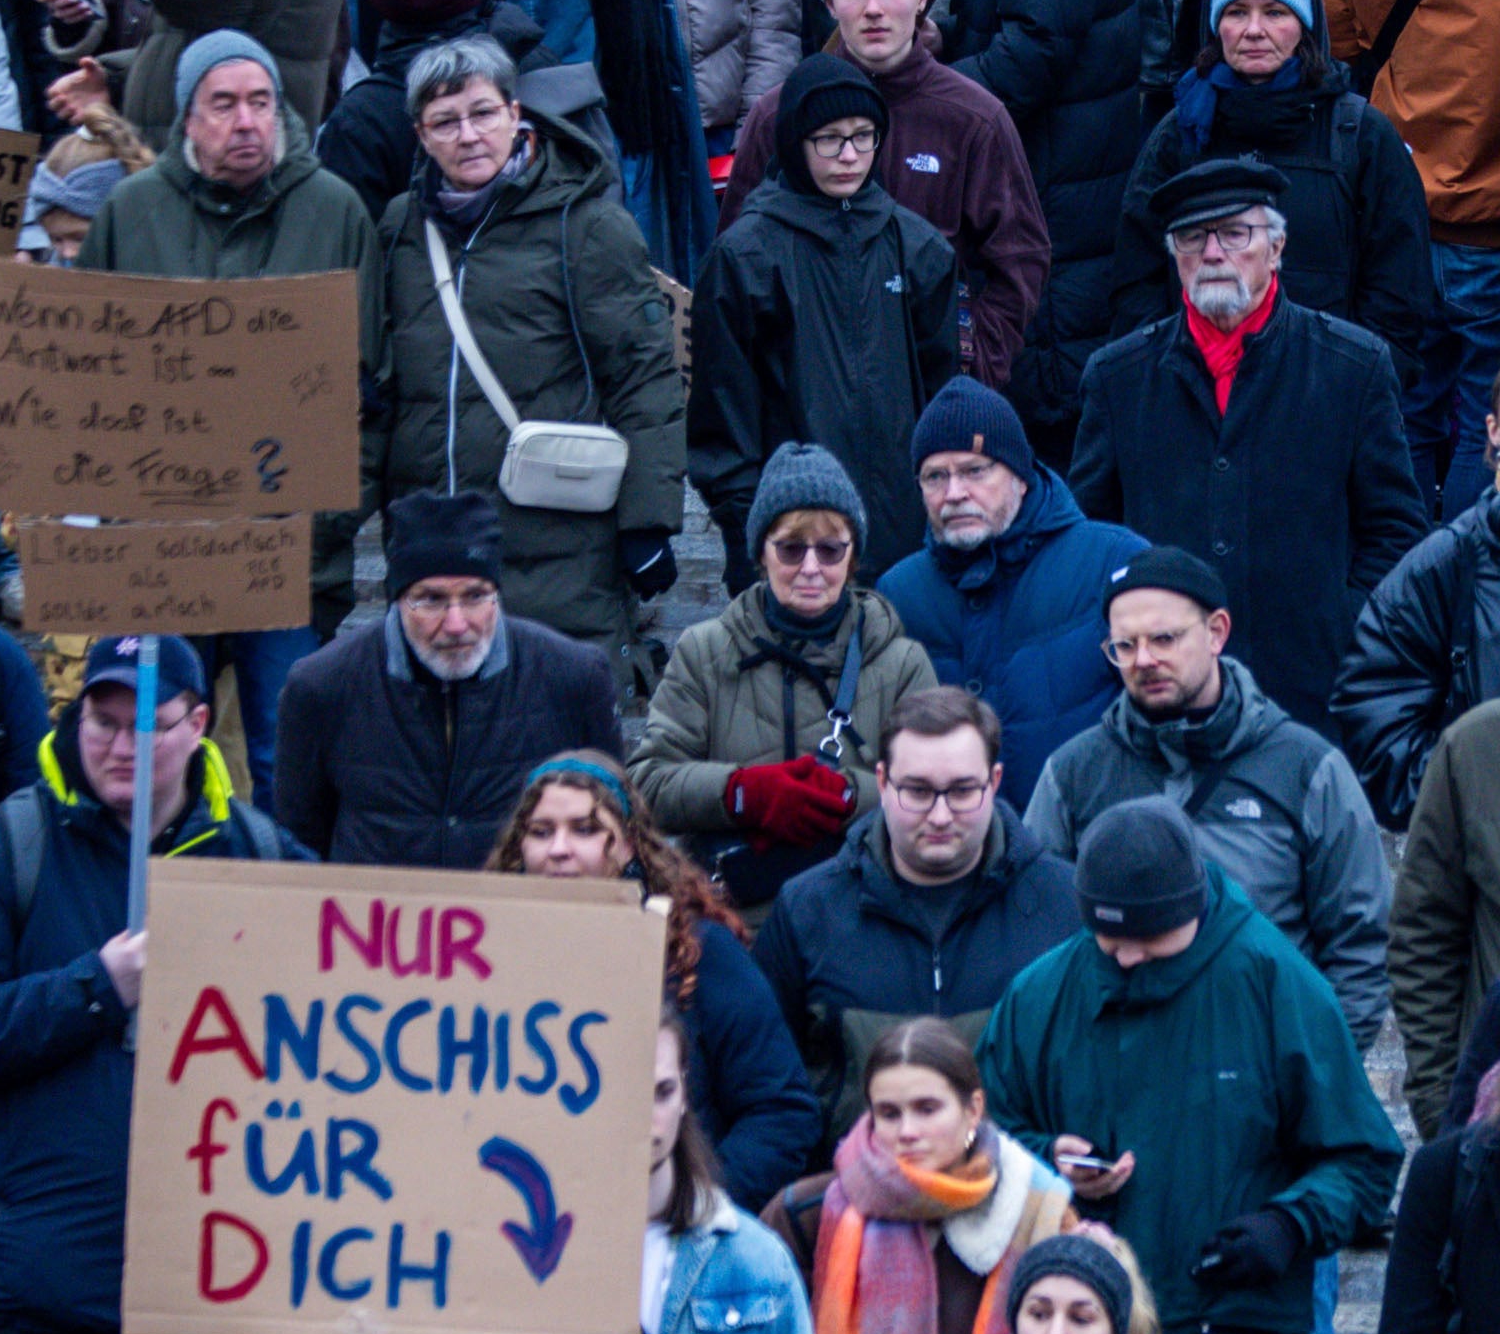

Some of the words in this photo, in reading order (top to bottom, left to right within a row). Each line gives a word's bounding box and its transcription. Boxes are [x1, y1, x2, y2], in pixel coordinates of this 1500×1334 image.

[92, 302, 140, 337] die
[247, 306, 300, 336] die
[0, 333, 127, 376] Antwort
[152, 343, 194, 384] ist
[79, 401, 147, 434] doof
[163, 410, 213, 435] ist
[53, 453, 117, 488] die
[127, 448, 242, 496] Frage
[30, 534, 130, 566] Lieber
[156, 531, 295, 560] solidarisch
[128, 567, 170, 589] als
[131, 594, 217, 619] arisch
[318, 896, 494, 980] NUR
[167, 985, 610, 1115] ANSCHISS
[199, 1210, 451, 1310] DICH
